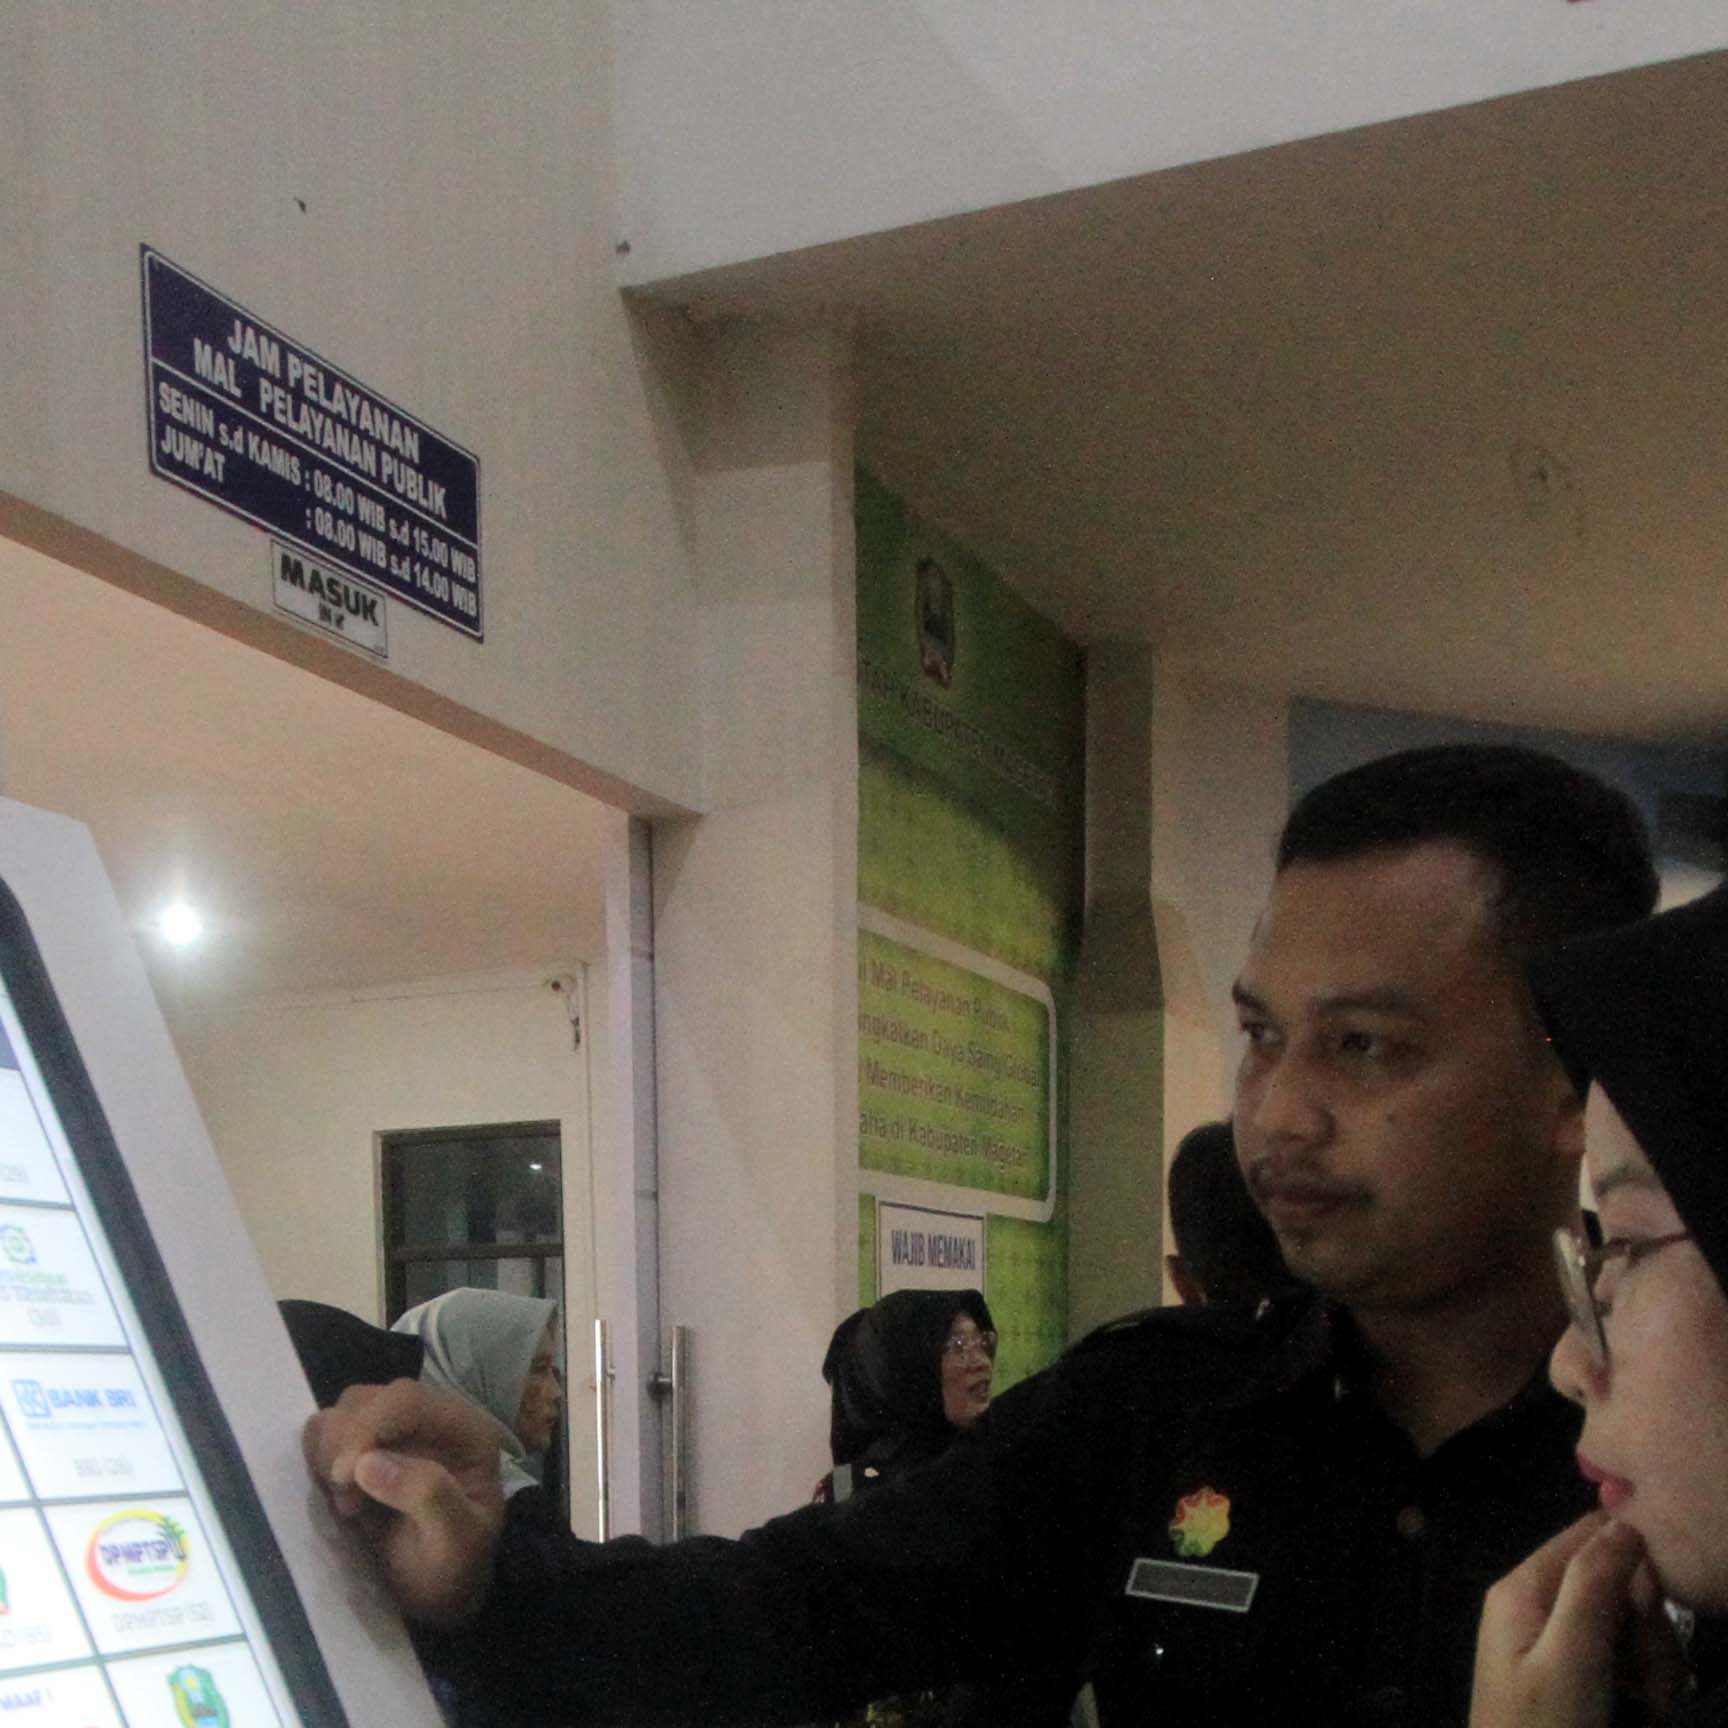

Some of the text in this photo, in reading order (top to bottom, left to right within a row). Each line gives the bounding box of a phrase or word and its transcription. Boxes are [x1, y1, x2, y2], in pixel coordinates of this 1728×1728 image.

[194, 338, 446, 519] MAL PELAYANAN PUBLIK
[228, 320, 419, 463] JAM PELAYANAN
[160, 382, 214, 438] SENIN
[220, 420, 245, 454] s.d
[249, 432, 300, 486] KAMIS
[313, 470, 354, 514] 08.00
[358, 494, 385, 531] WIB
[390, 518, 409, 544] s.d
[414, 520, 446, 561] 15.00
[451, 548, 475, 582] WIB
[161, 426, 225, 483] JUM'AT
[315, 510, 354, 552] 08.00
[359, 534, 386, 570] WIB
[391, 550, 410, 582] s.d
[414, 561, 448, 602] 14.00
[453, 584, 477, 616] WIB
[281, 553, 379, 626] MASUK
[891, 1229, 924, 1267] WAJIB
